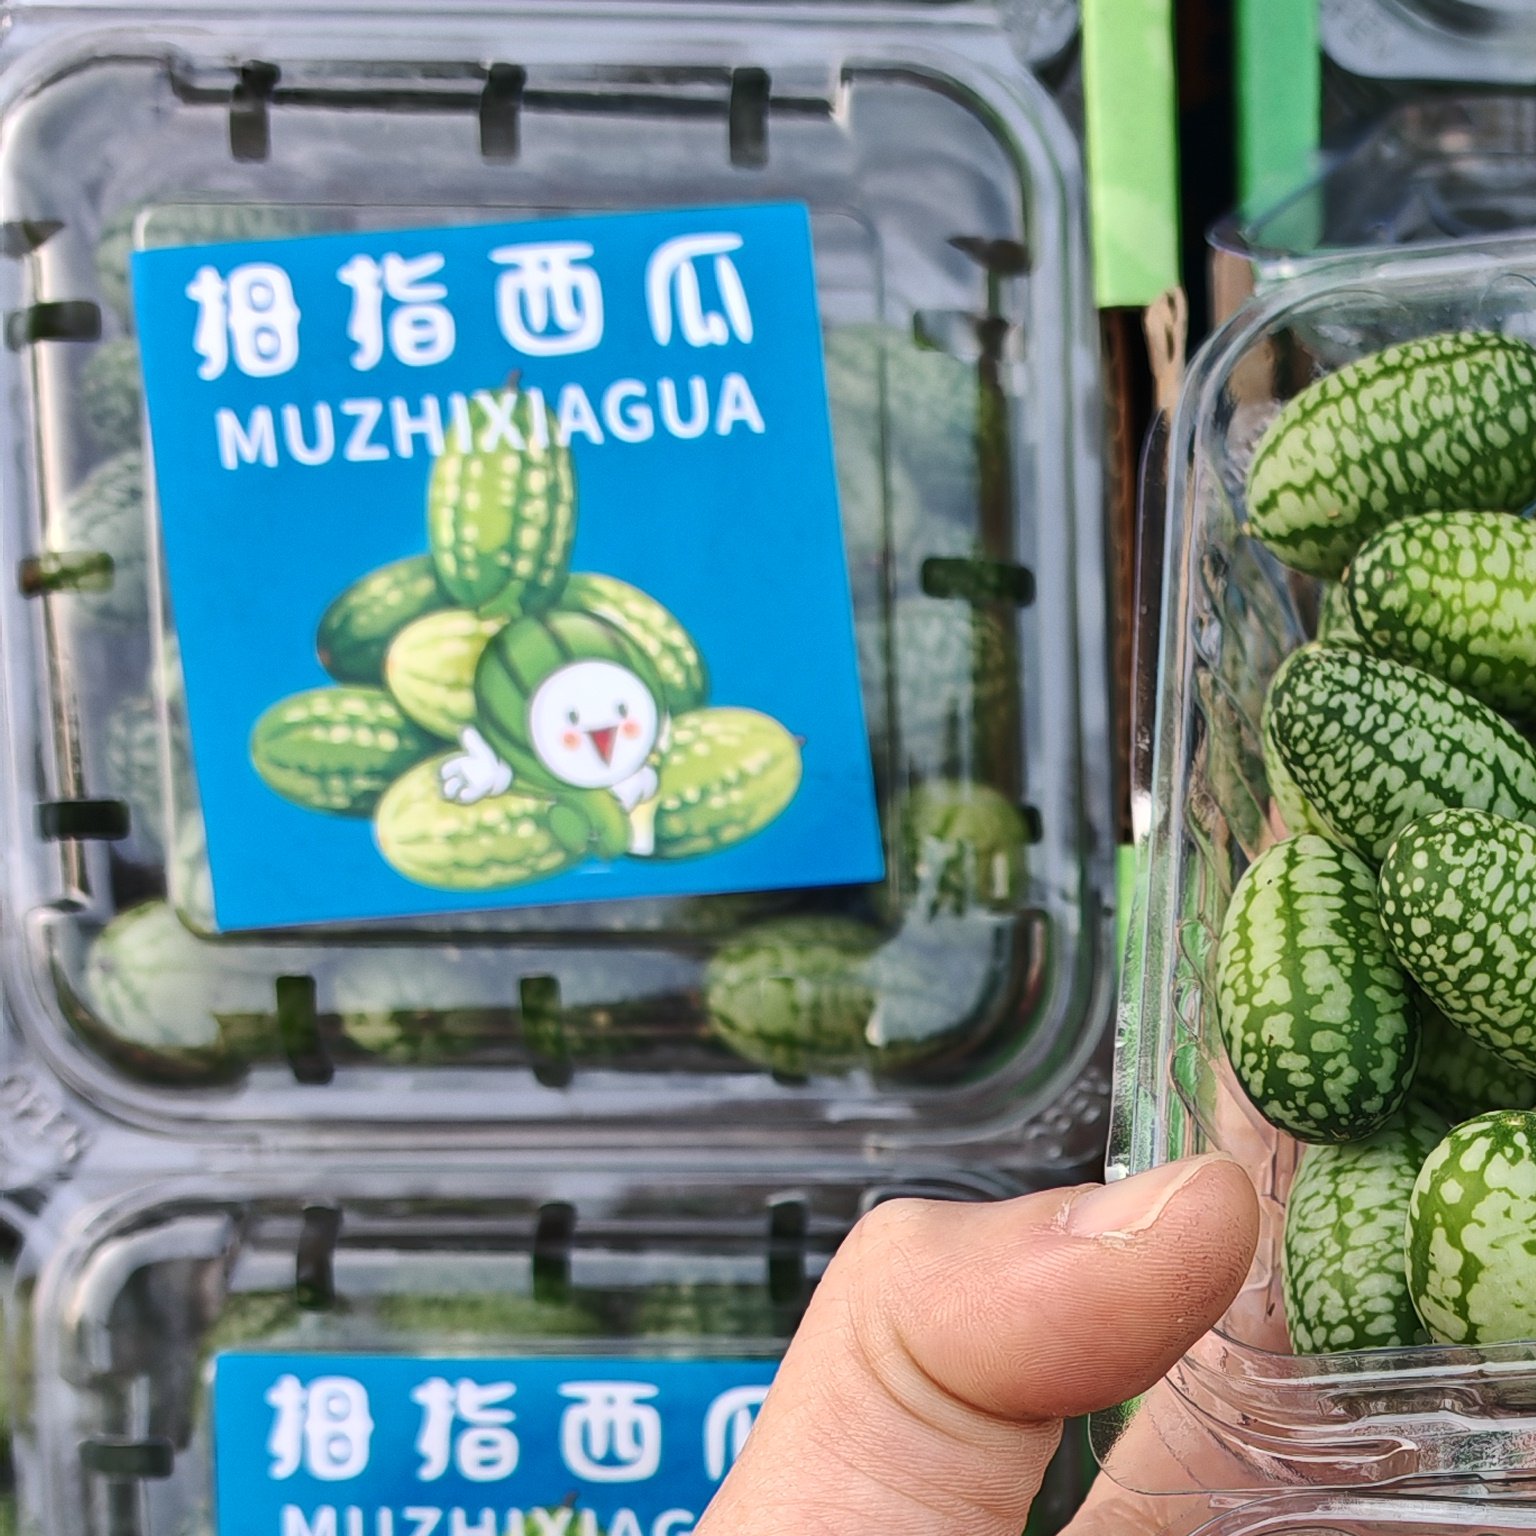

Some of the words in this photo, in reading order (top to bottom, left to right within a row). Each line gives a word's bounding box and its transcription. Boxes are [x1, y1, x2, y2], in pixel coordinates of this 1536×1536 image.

[186, 232, 754, 381] 拇指西瓜
[215, 373, 765, 470] MUZHIXIAGUA
